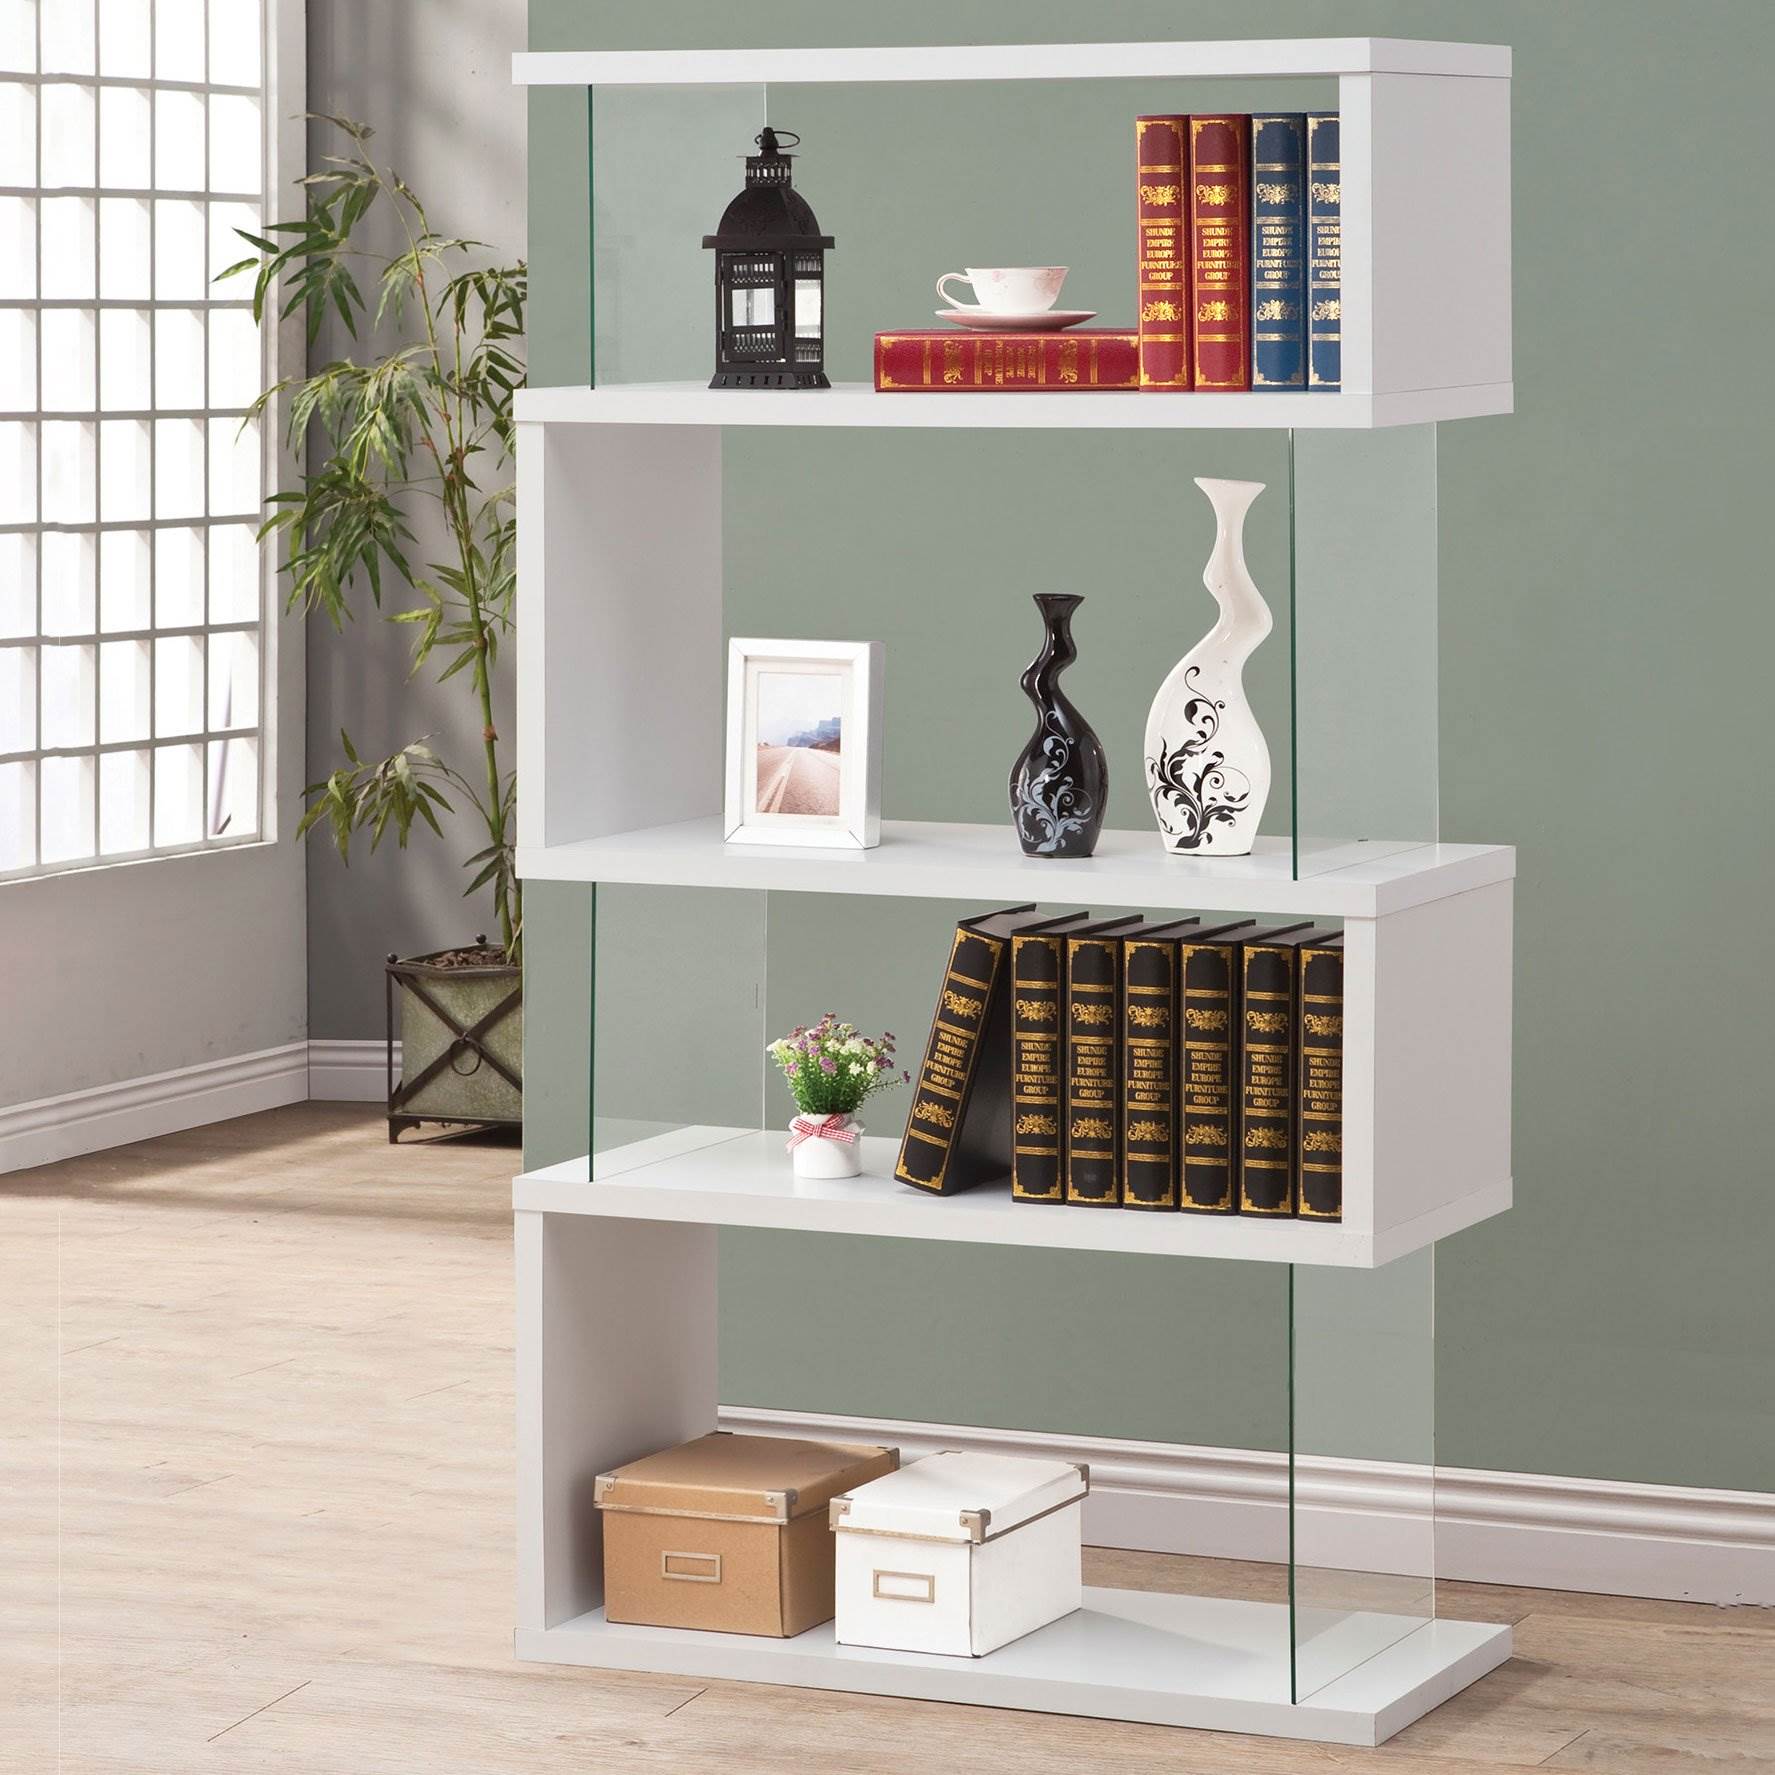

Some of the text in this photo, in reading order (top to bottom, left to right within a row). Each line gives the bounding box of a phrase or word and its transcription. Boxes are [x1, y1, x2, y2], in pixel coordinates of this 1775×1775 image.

[1147, 250, 1175, 258] EUROPE
[1149, 272, 1173, 280] GROUP
[939, 1032, 967, 1048] SHUNDE
[937, 1042, 965, 1057] EMPIRE
[1021, 1042, 1052, 1051] SHUNDE
[1077, 1046, 1106, 1055] SHUNDE
[1022, 1053, 1050, 1061] EMPIRE
[1133, 1048, 1164, 1057] SHUNDE
[1191, 1052, 1222, 1061] SHUNDE
[934, 1052, 962, 1068] EUROPE
[1078, 1056, 1105, 1065] EMPIRE
[1252, 1054, 1282, 1063] SHUNDE
[1309, 1058, 1340, 1067] SHUNDE
[1022, 1064, 1051, 1072] EUROPE
[1134, 1059, 1163, 1068] EMPIRE
[1192, 1063, 1221, 1072] EMPIRE
[926, 1060, 967, 1080] FURNITURE
[1077, 1067, 1105, 1076] EUROPE
[1252, 1065, 1281, 1074] EMPIRE
[1310, 1068, 1339, 1078] EMPIRE
[1134, 1070, 1163, 1079] EUROPE
[1191, 1073, 1222, 1082] EUROPE
[931, 1074, 955, 1087] GROUP
[1252, 1076, 1282, 1085] EUROPE
[1309, 1080, 1339, 1089] EUROPE
[1024, 1085, 1048, 1094] GROUP
[1079, 1089, 1104, 1098] GROUP
[1136, 1092, 1160, 1101] GROUP
[1194, 1096, 1219, 1104] GROUP
[1253, 1098, 1280, 1108] GROUP
[1311, 1101, 1337, 1110] GROUP
